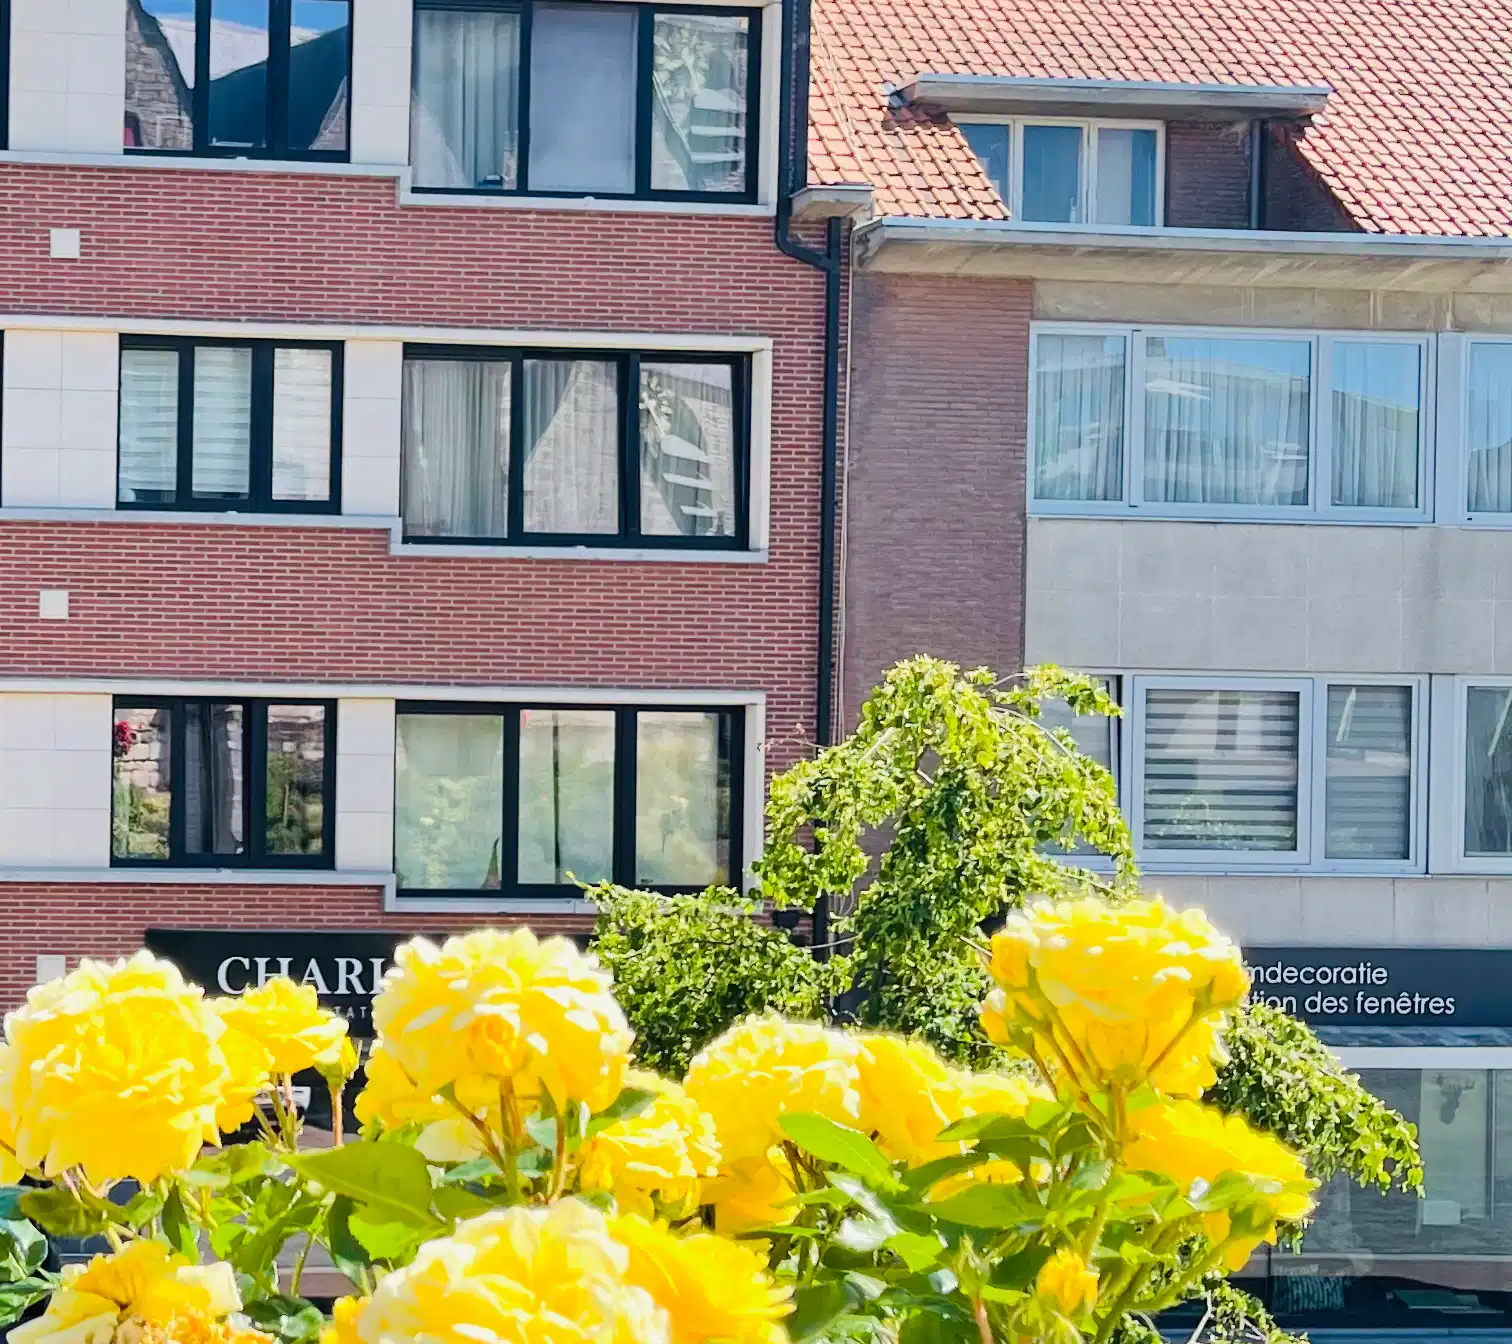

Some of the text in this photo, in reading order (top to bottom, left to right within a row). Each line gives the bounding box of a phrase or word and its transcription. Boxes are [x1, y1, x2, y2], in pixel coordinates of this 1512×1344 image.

[1245, 990, 1456, 1015] tion des fenêtres
